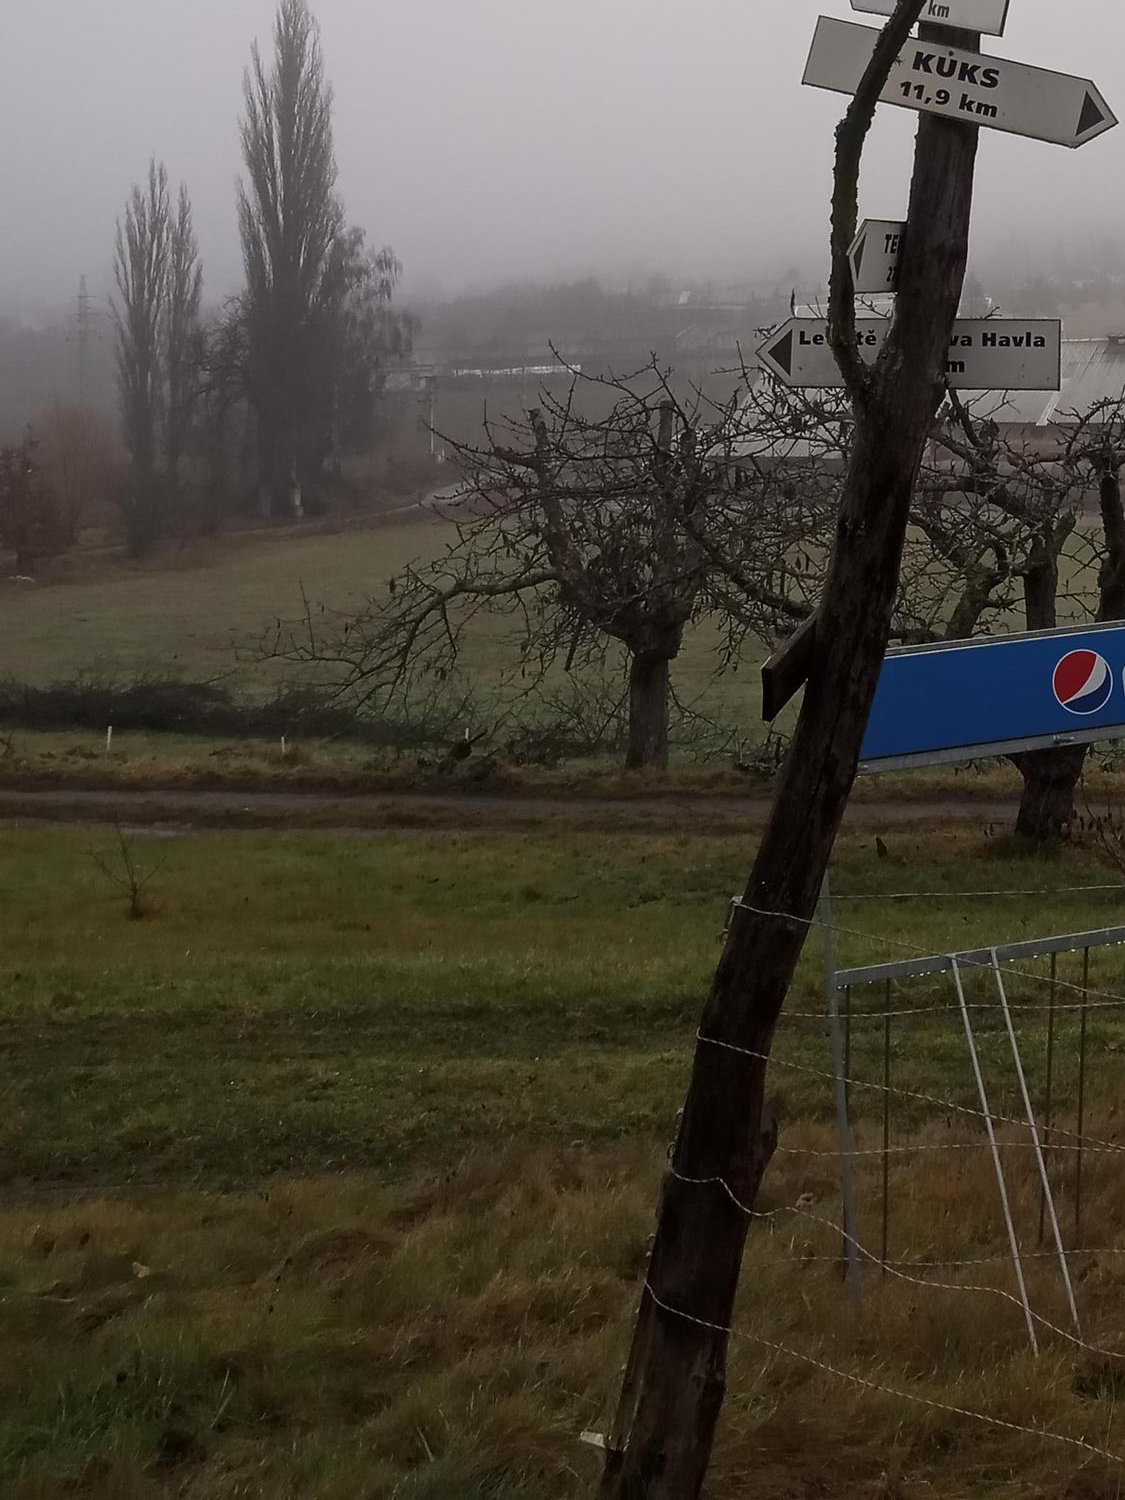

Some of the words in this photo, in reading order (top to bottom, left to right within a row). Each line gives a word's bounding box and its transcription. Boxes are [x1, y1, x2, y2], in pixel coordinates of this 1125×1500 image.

[927, 0, 950, 18] km
[912, 51, 1000, 89] KUKS
[900, 81, 950, 105] 11,9
[958, 93, 999, 118] km
[982, 332, 1046, 348] Havla
